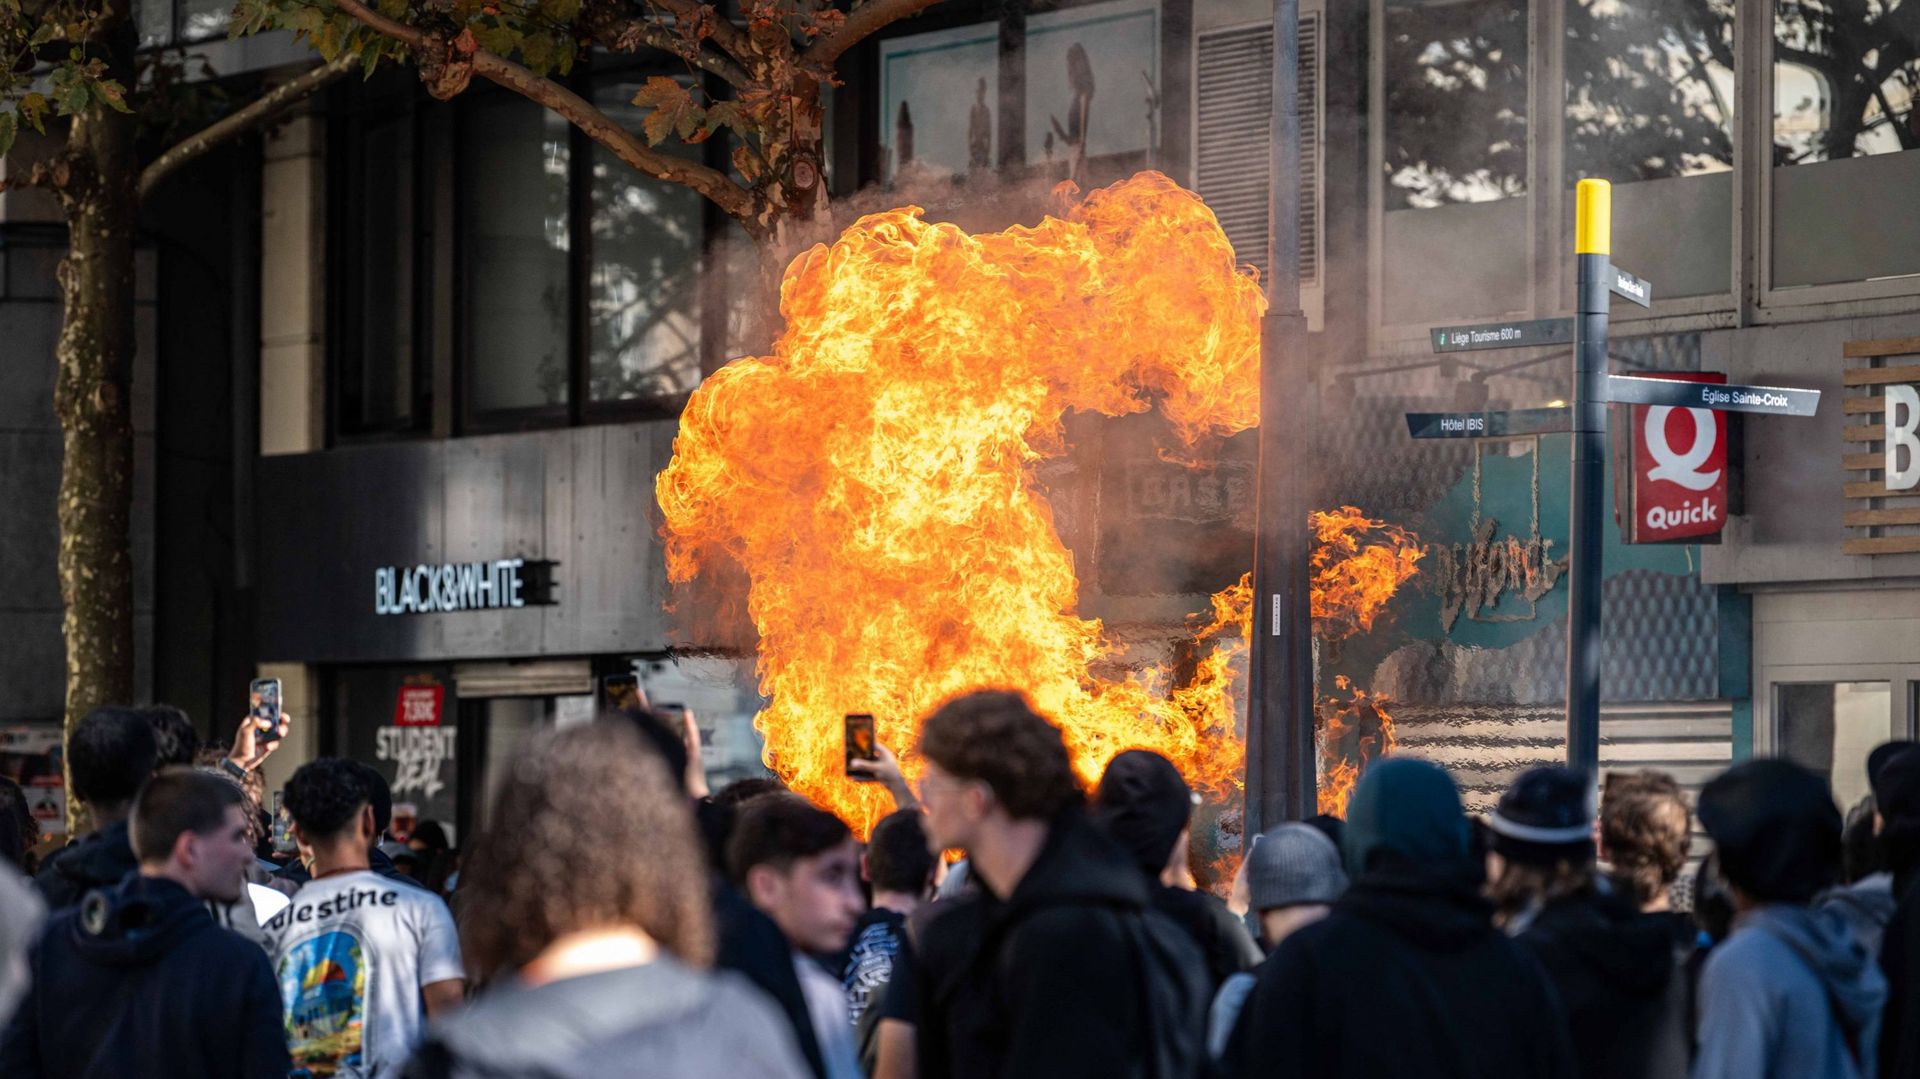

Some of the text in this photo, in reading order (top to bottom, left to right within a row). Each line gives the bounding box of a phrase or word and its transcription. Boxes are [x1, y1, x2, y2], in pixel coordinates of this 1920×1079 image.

[1470, 330, 1500, 342] Tourisme
[1501, 328, 1513, 340] 600
[1514, 329, 1521, 339] m
[1702, 387, 1788, 407] Église Sainte-Croix
[1441, 418, 1484, 431] Hôtel IBIS
[1644, 405, 1721, 491] Q
[1646, 497, 1718, 530] Quick
[375, 557, 525, 615] BLACK&WHITE
[375, 724, 458, 761] STUDENT
[265, 886, 399, 931] alestine
